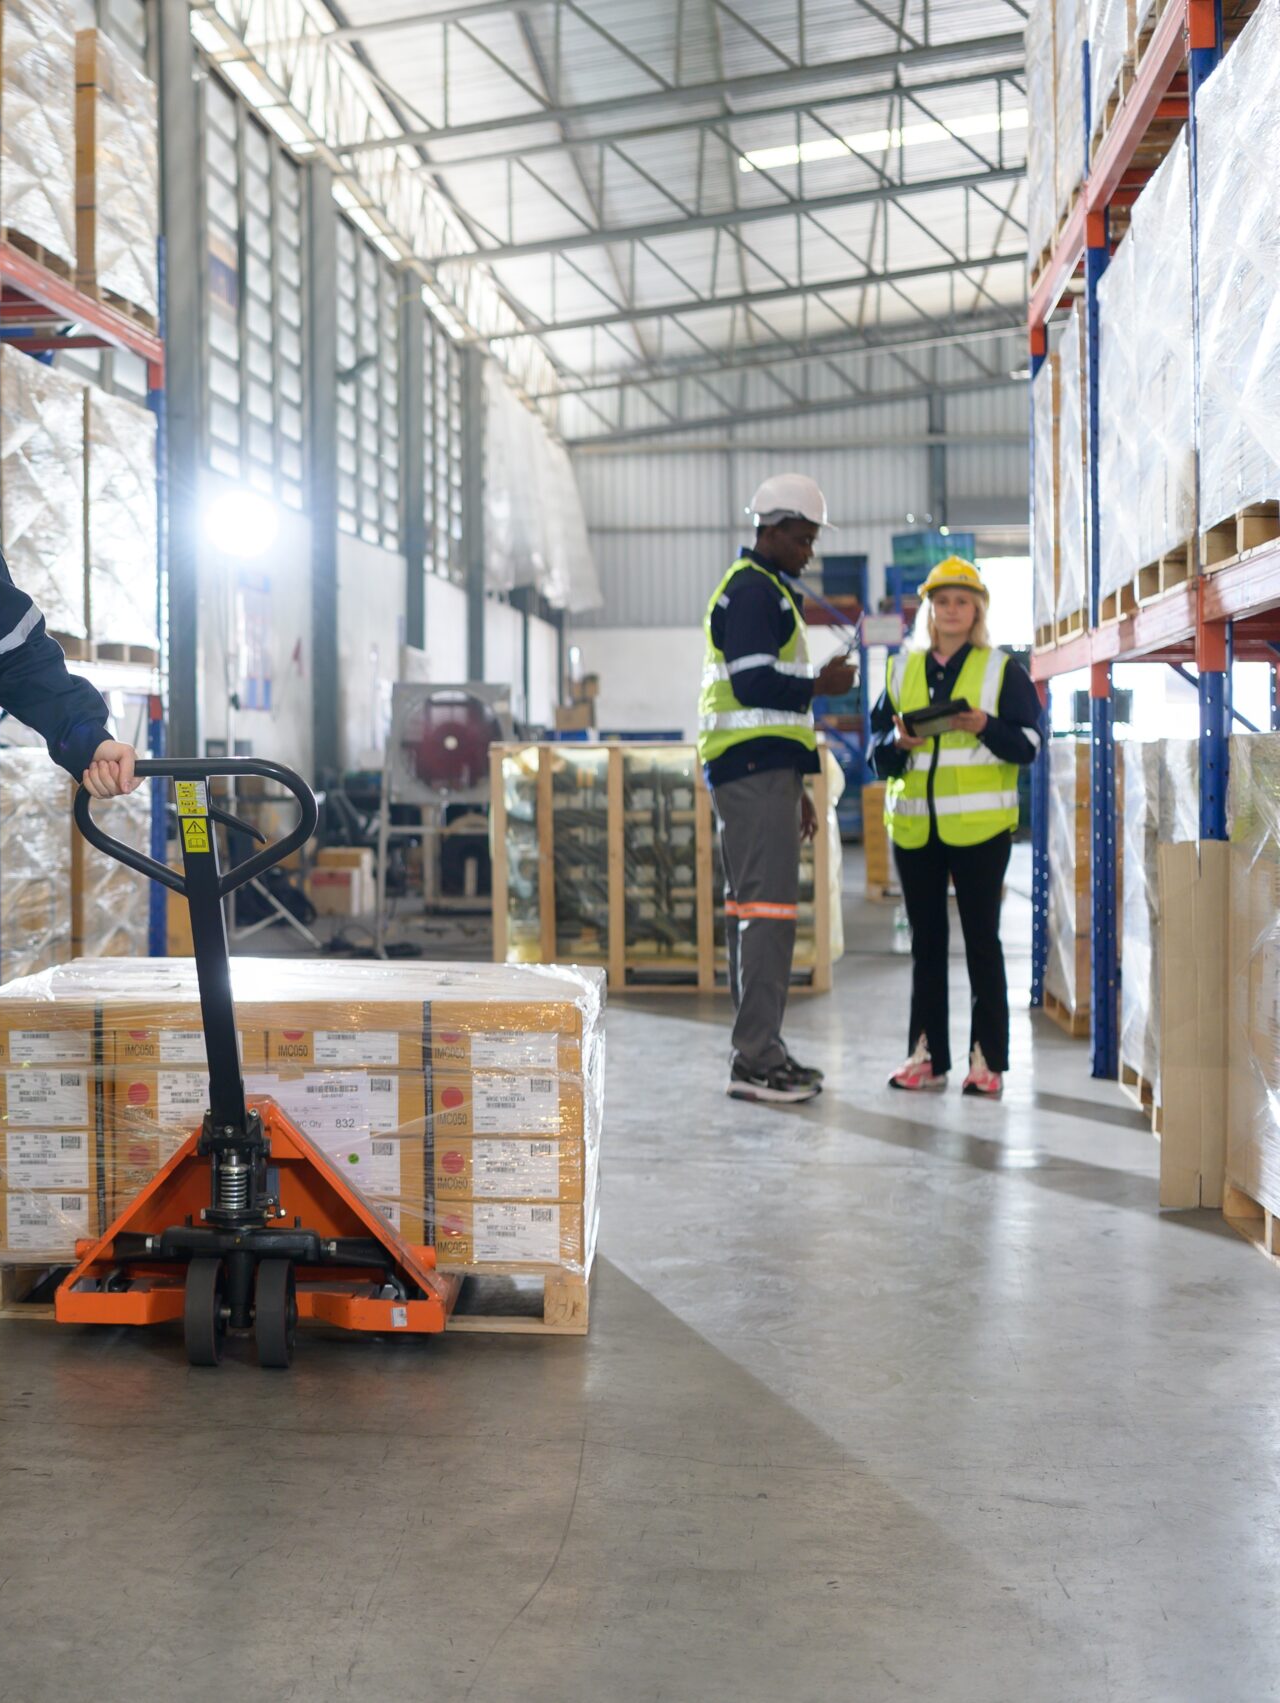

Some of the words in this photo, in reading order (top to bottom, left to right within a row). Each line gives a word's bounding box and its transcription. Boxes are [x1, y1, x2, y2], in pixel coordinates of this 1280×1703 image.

[124, 1044, 154, 1056] IMC050
[278, 1045, 309, 1057] IMC050
[335, 1118, 356, 1129] 832
[437, 1113, 468, 1126] IMC050
